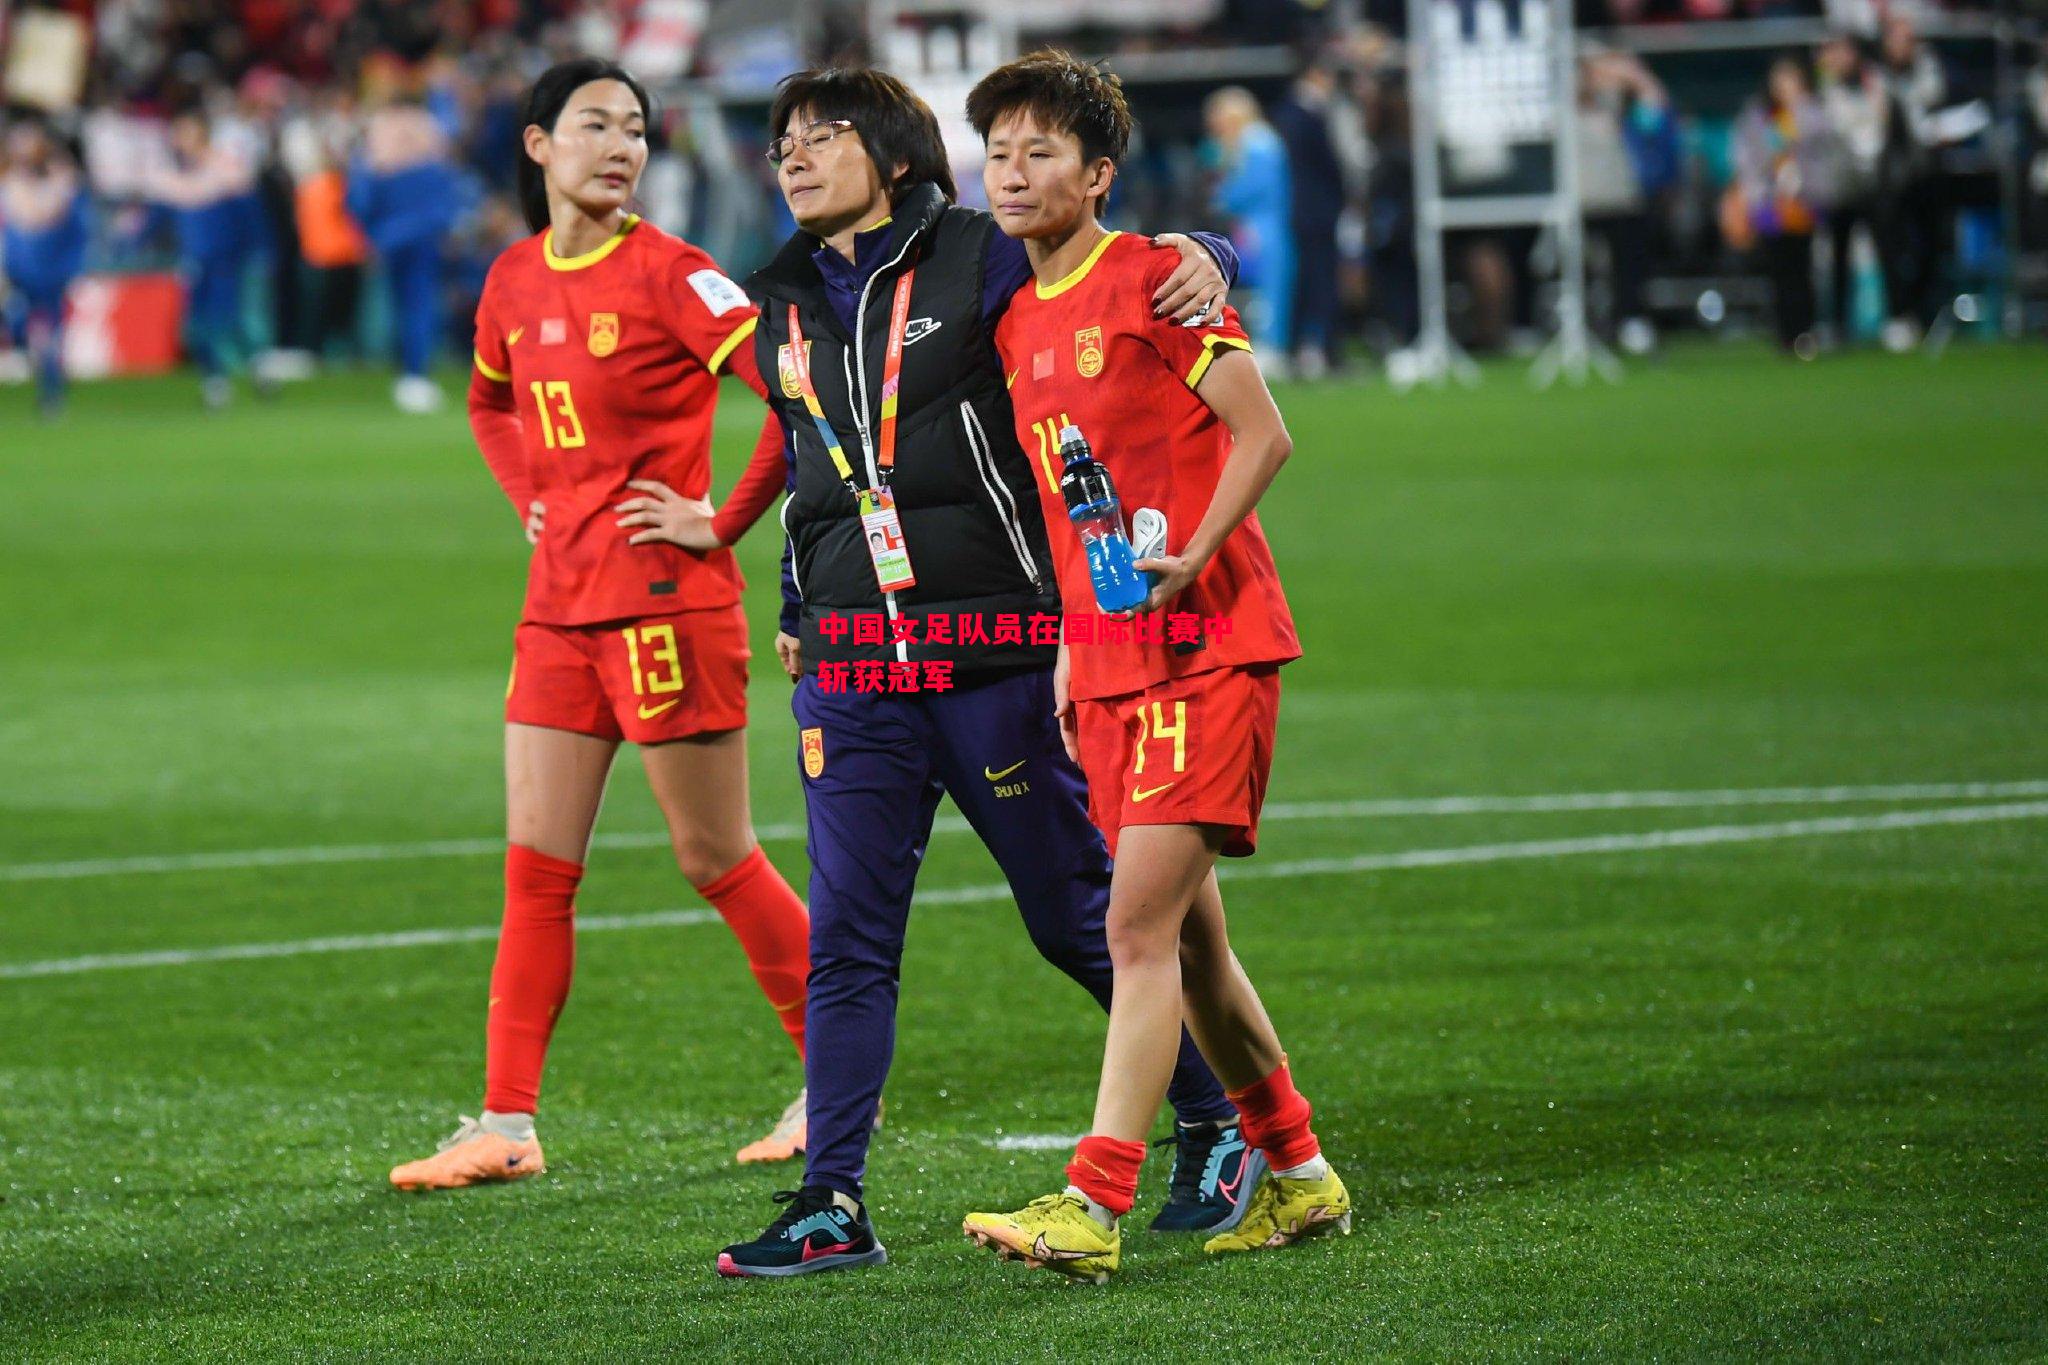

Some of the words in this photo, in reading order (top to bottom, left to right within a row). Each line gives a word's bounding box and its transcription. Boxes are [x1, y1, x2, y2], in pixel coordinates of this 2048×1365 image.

[530, 380, 586, 449] 13
[622, 624, 684, 695] 13
[1134, 701, 1186, 774] 14
